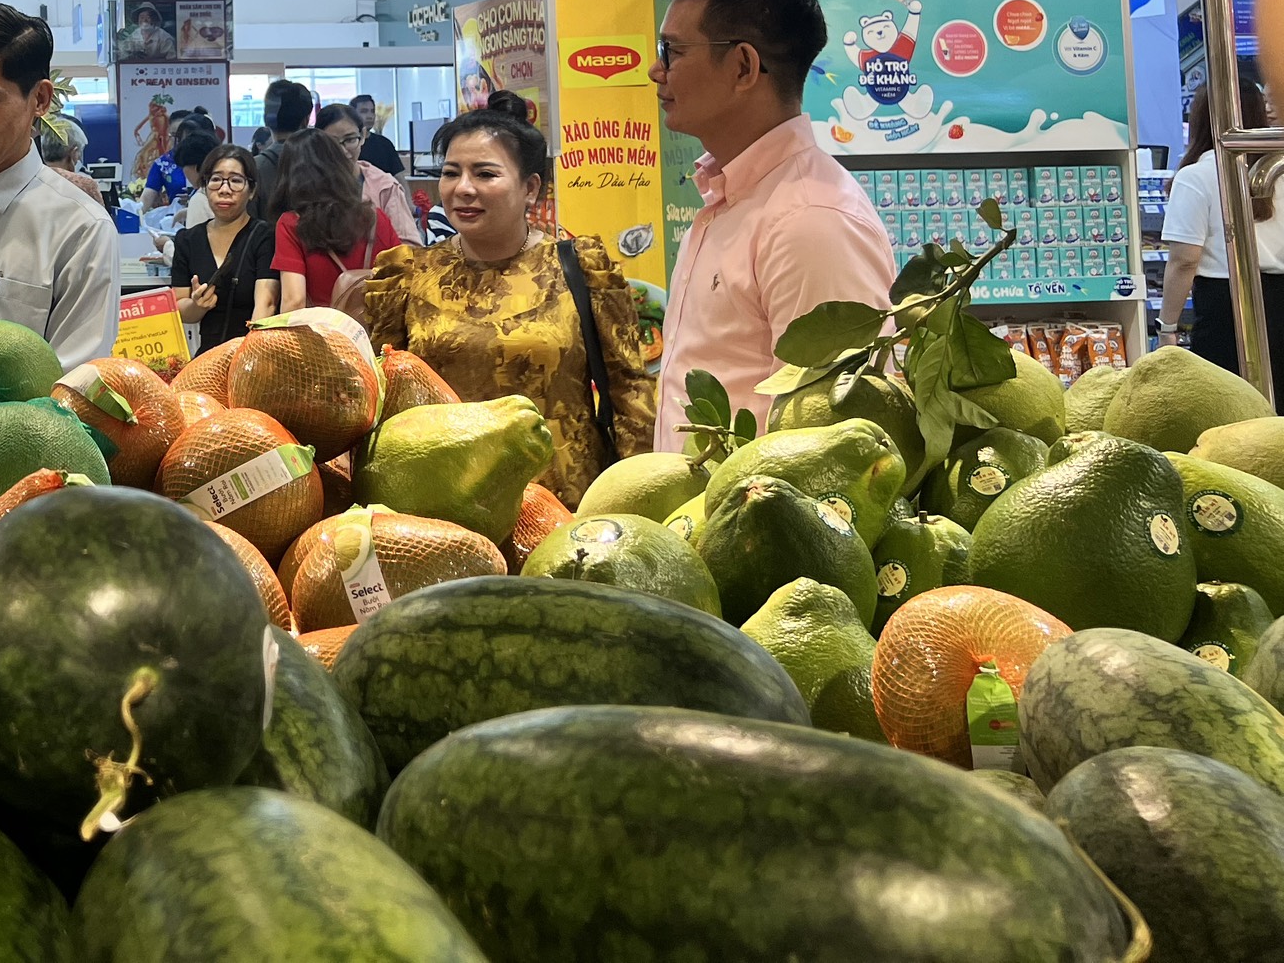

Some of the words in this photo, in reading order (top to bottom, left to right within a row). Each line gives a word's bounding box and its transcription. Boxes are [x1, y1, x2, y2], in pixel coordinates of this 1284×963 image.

[477, 7, 497, 34] CHO
[497, 0, 521, 25] CƠM
[480, 31, 503, 55] NGON
[503, 25, 526, 49] SÁNG
[527, 28, 546, 49] TẠO
[576, 53, 632, 67] Maggi
[511, 60, 533, 80] CHỌN
[175, 78, 220, 86] GINSENG
[563, 120, 590, 143] XÀO
[593, 117, 620, 139] ÓNG
[623, 117, 651, 141] ÁNH
[119, 303, 145, 318] mãi
[134, 341, 163, 358] 300
[206, 484, 225, 514] Select
[351, 582, 384, 599] Select
